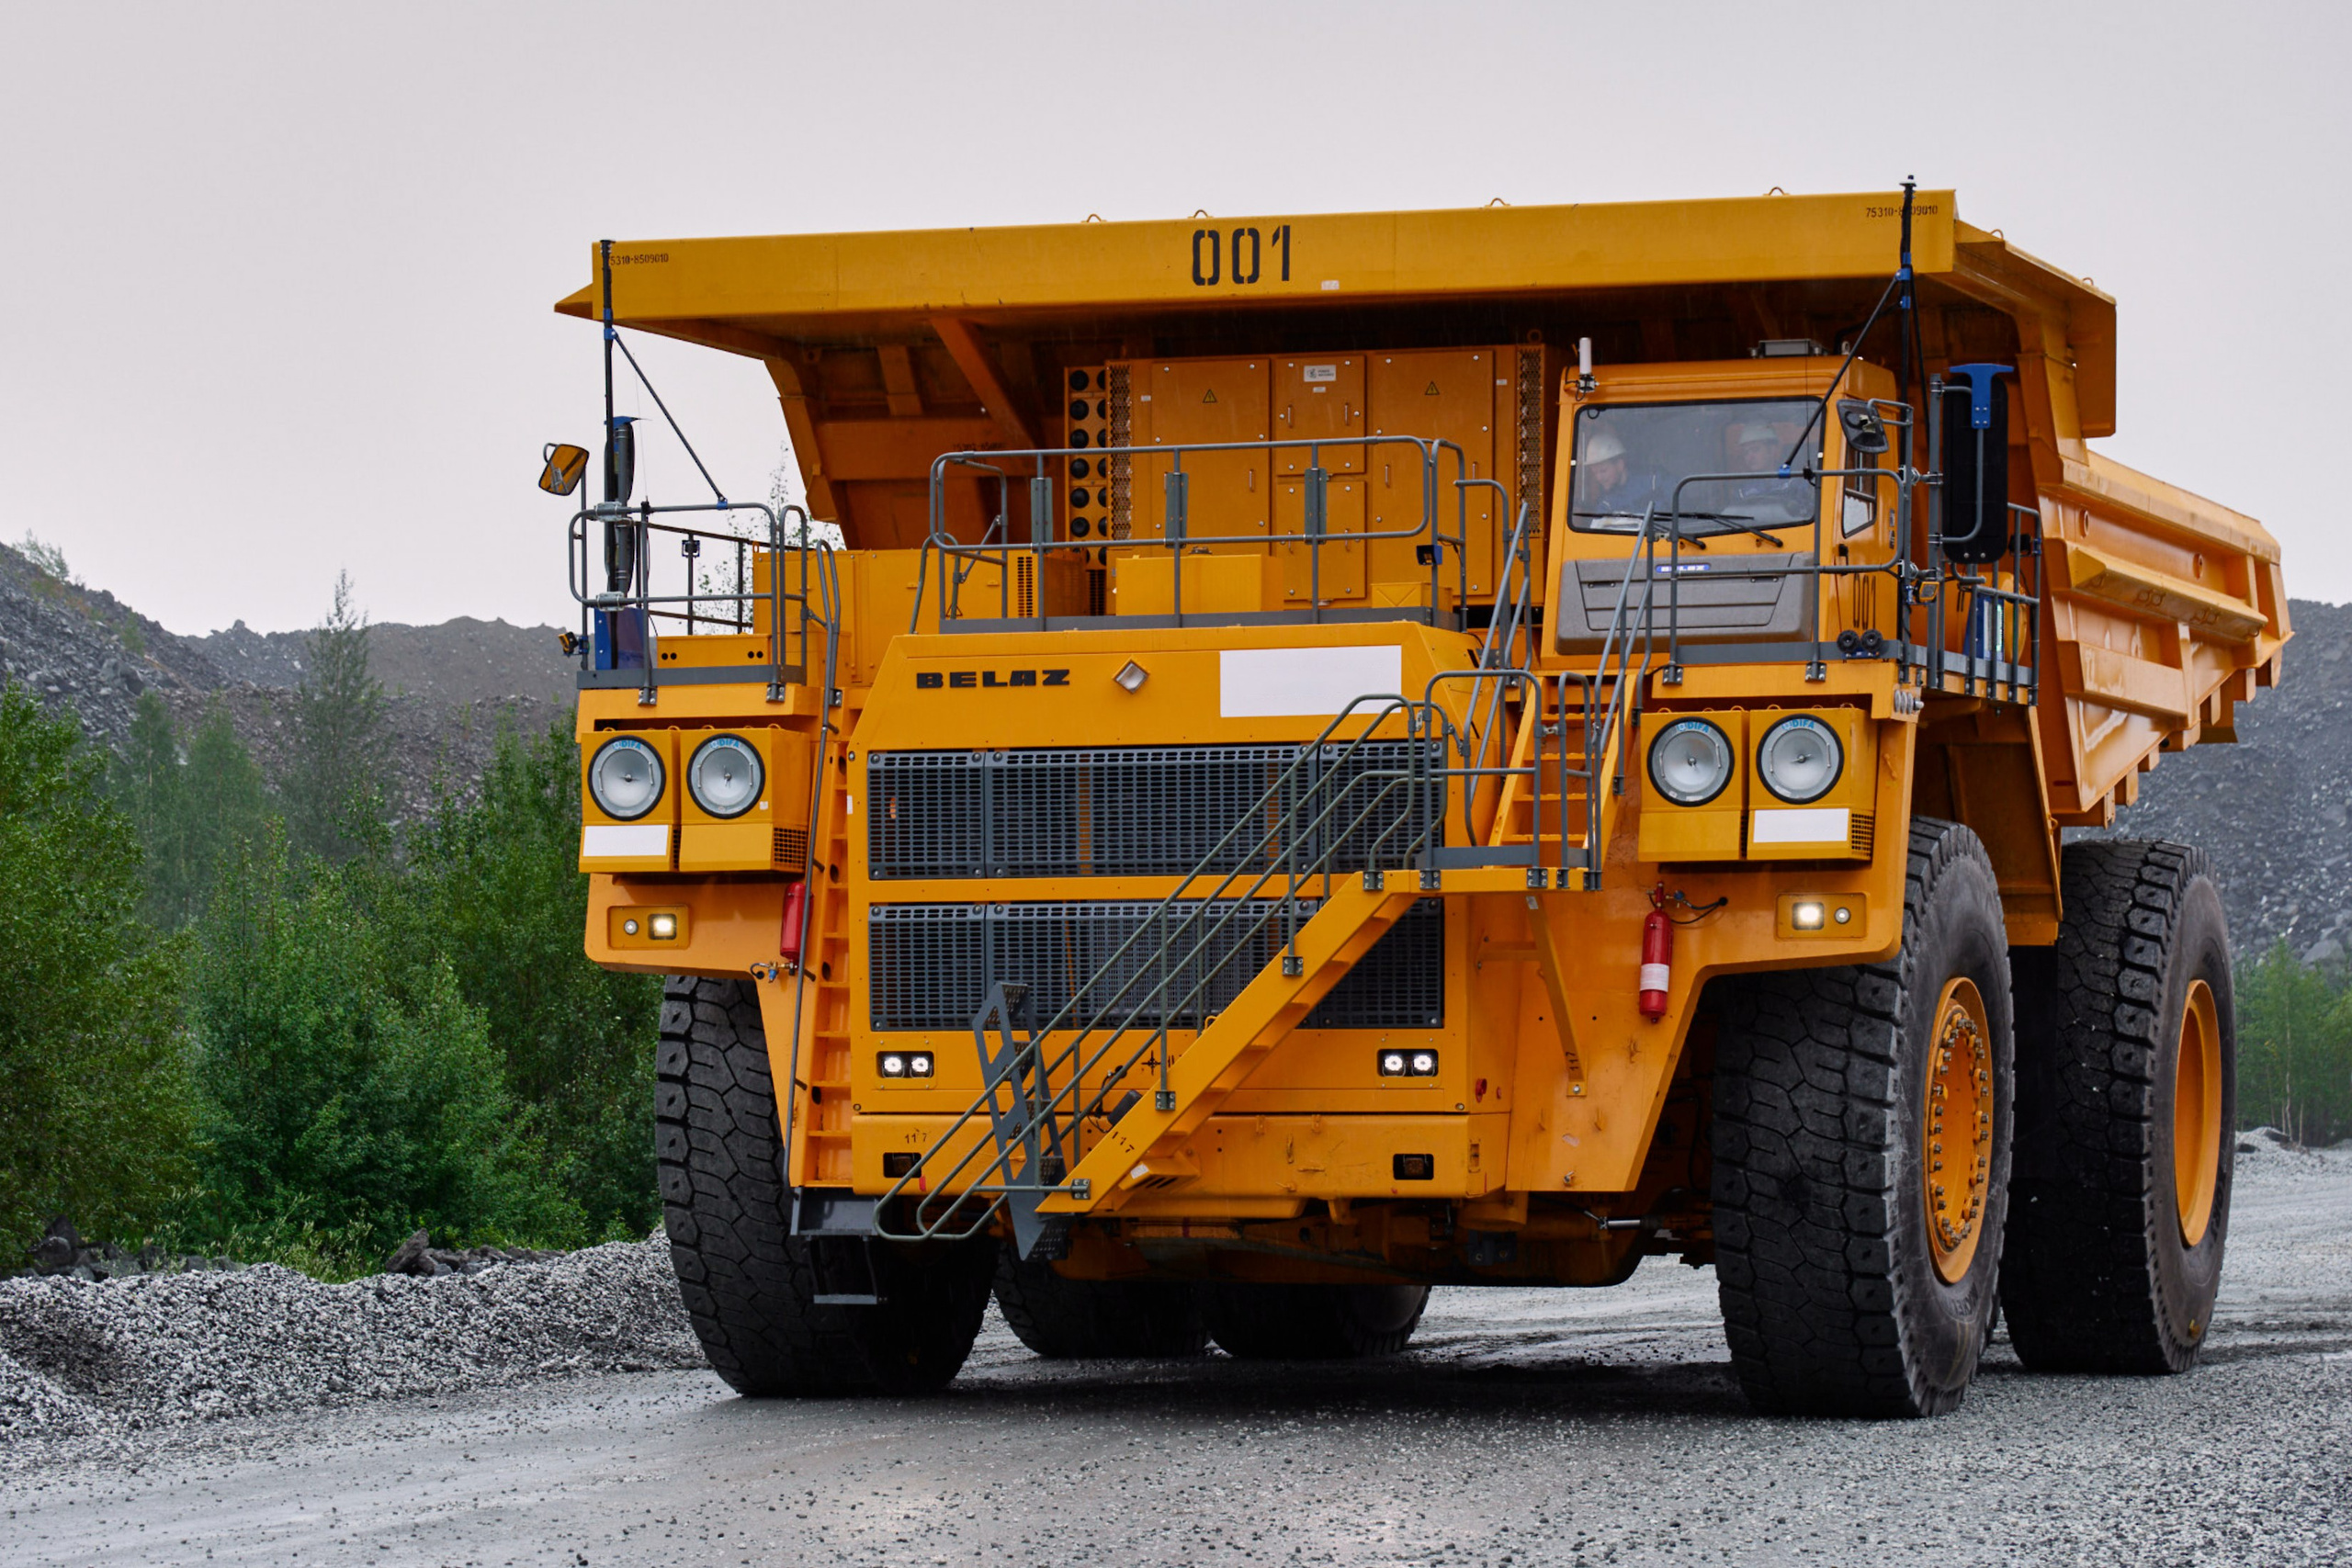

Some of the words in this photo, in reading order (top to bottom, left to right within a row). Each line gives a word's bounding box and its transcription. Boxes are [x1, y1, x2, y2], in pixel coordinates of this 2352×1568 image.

[1866, 205, 1938, 218] 75310-809010
[608, 253, 669, 265] 5310-8509010
[1193, 225, 1290, 286] 001
[1853, 571, 1876, 631] 001
[916, 670, 1070, 689] BELAZ
[1687, 721, 1710, 734] DIFA
[1792, 718, 1815, 729] DIFA
[621, 739, 642, 750] DIFA
[718, 738, 741, 749] DIFA
